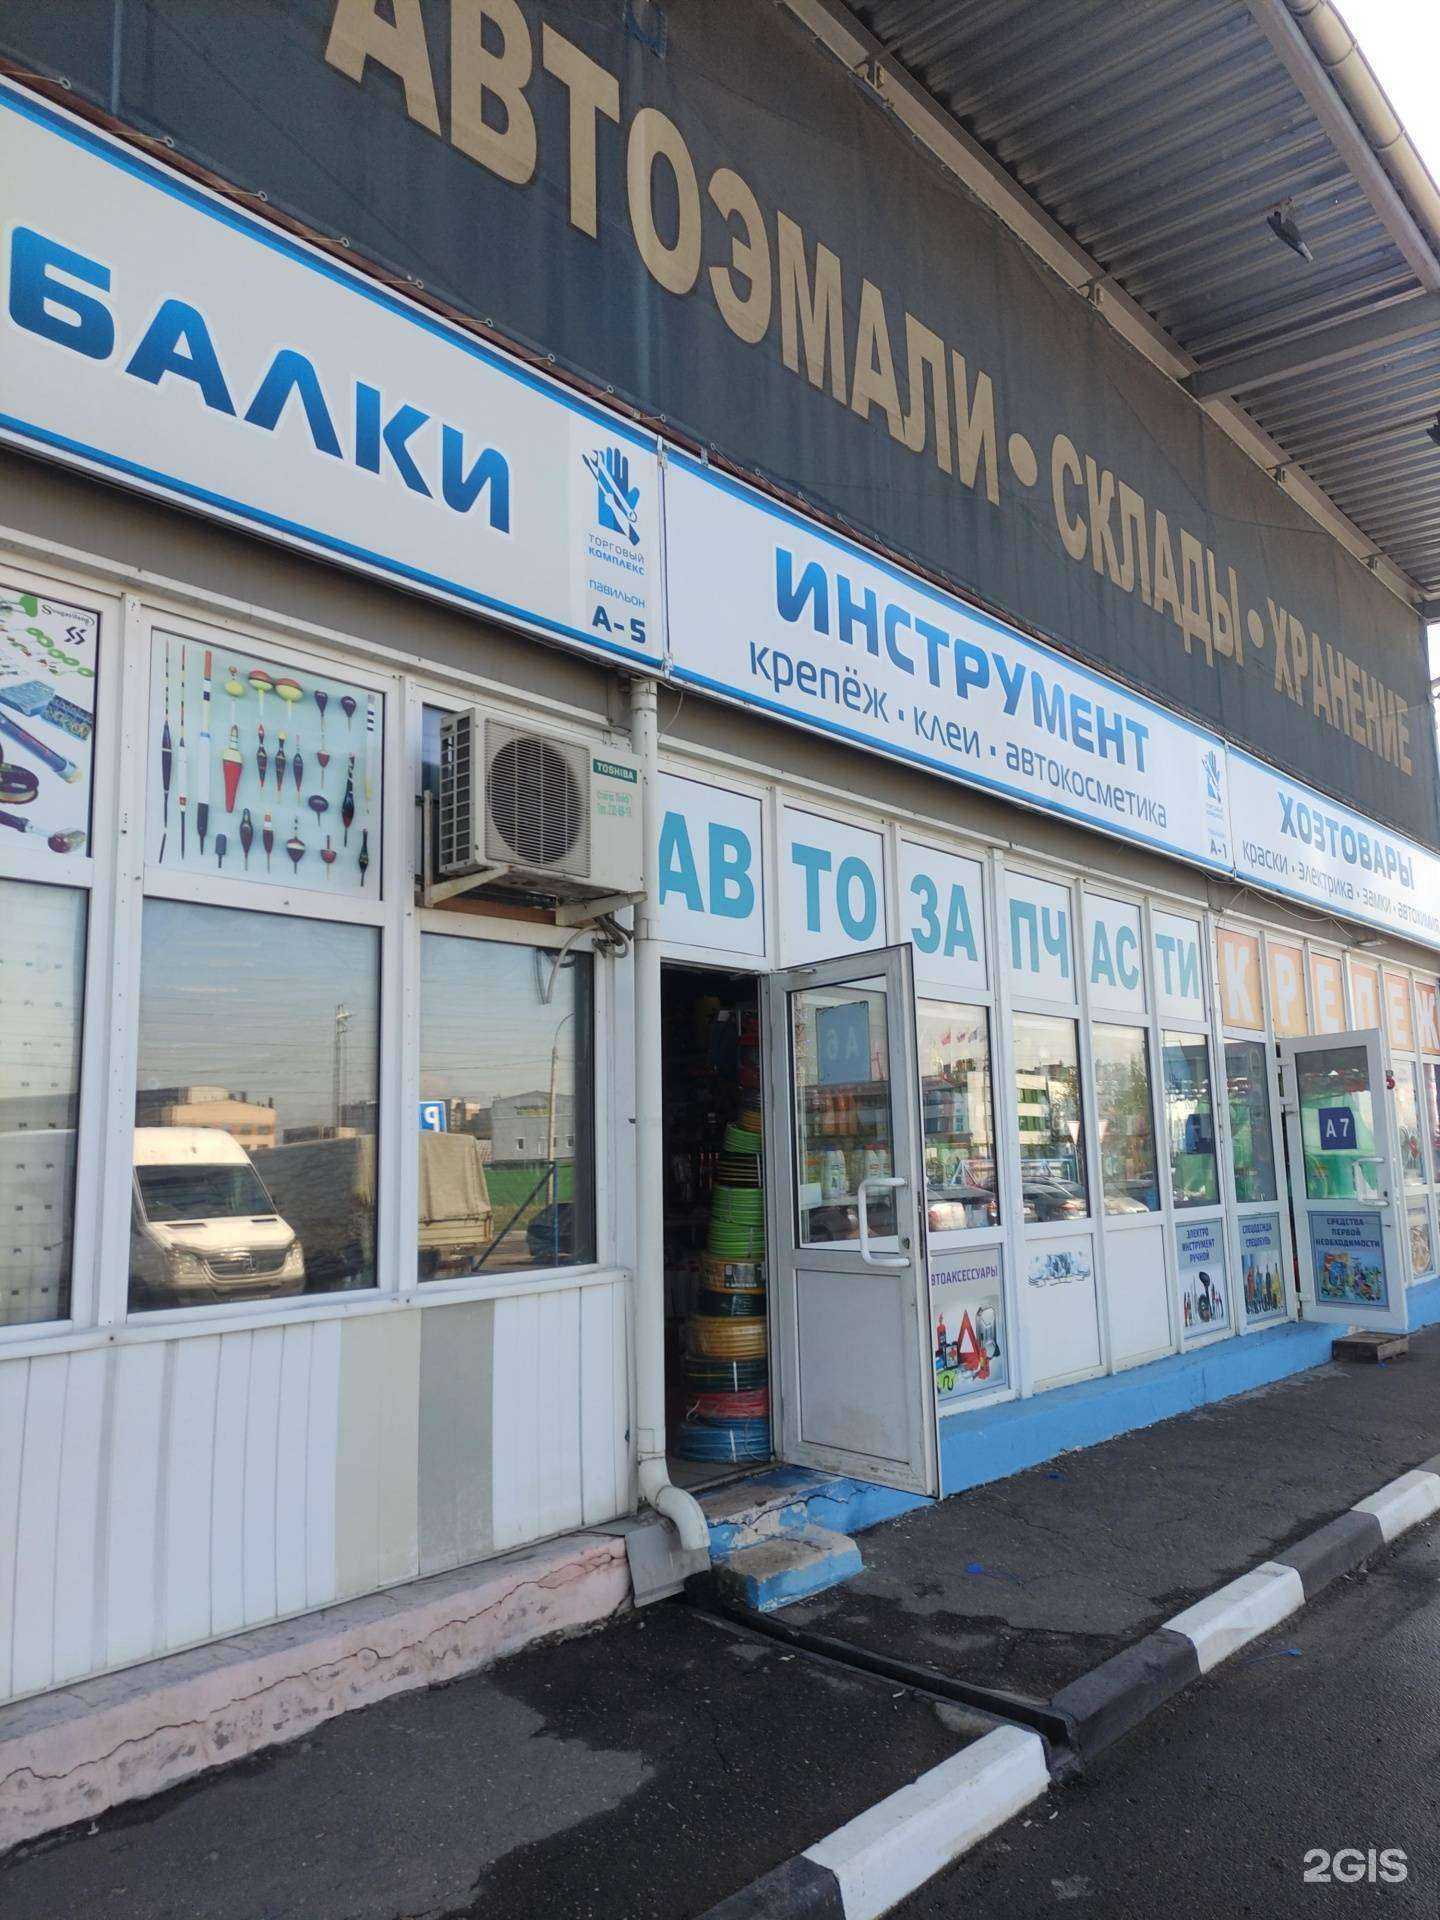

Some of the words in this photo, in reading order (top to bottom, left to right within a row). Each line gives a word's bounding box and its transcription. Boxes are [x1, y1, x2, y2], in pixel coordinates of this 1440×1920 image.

[8, 225, 511, 534] БАЛКИ
[324, 0, 1001, 507] АВТОЭМАЛИ
[1051, 433, 1244, 668] СКЛАДЫ
[1266, 596, 1414, 777] ХРАНЕНИЕ
[588, 532, 645, 563] ТОРГОВЫЙ
[588, 547, 645, 576] КОМПЛЕКС
[775, 545, 1150, 774] ИНСТРУМЕНТ
[596, 761, 634, 781] TOSHIBA
[749, 640, 890, 724] крепёж
[913, 704, 981, 759] клеи
[1005, 740, 1168, 829] автокосметика
[1242, 839, 1289, 876] краски
[1298, 860, 1354, 901] электрика
[1277, 790, 1416, 890] ХОЗТОВАРЫ
[930, 1265, 999, 1287] ВТОАКСЕССУАРЫ
